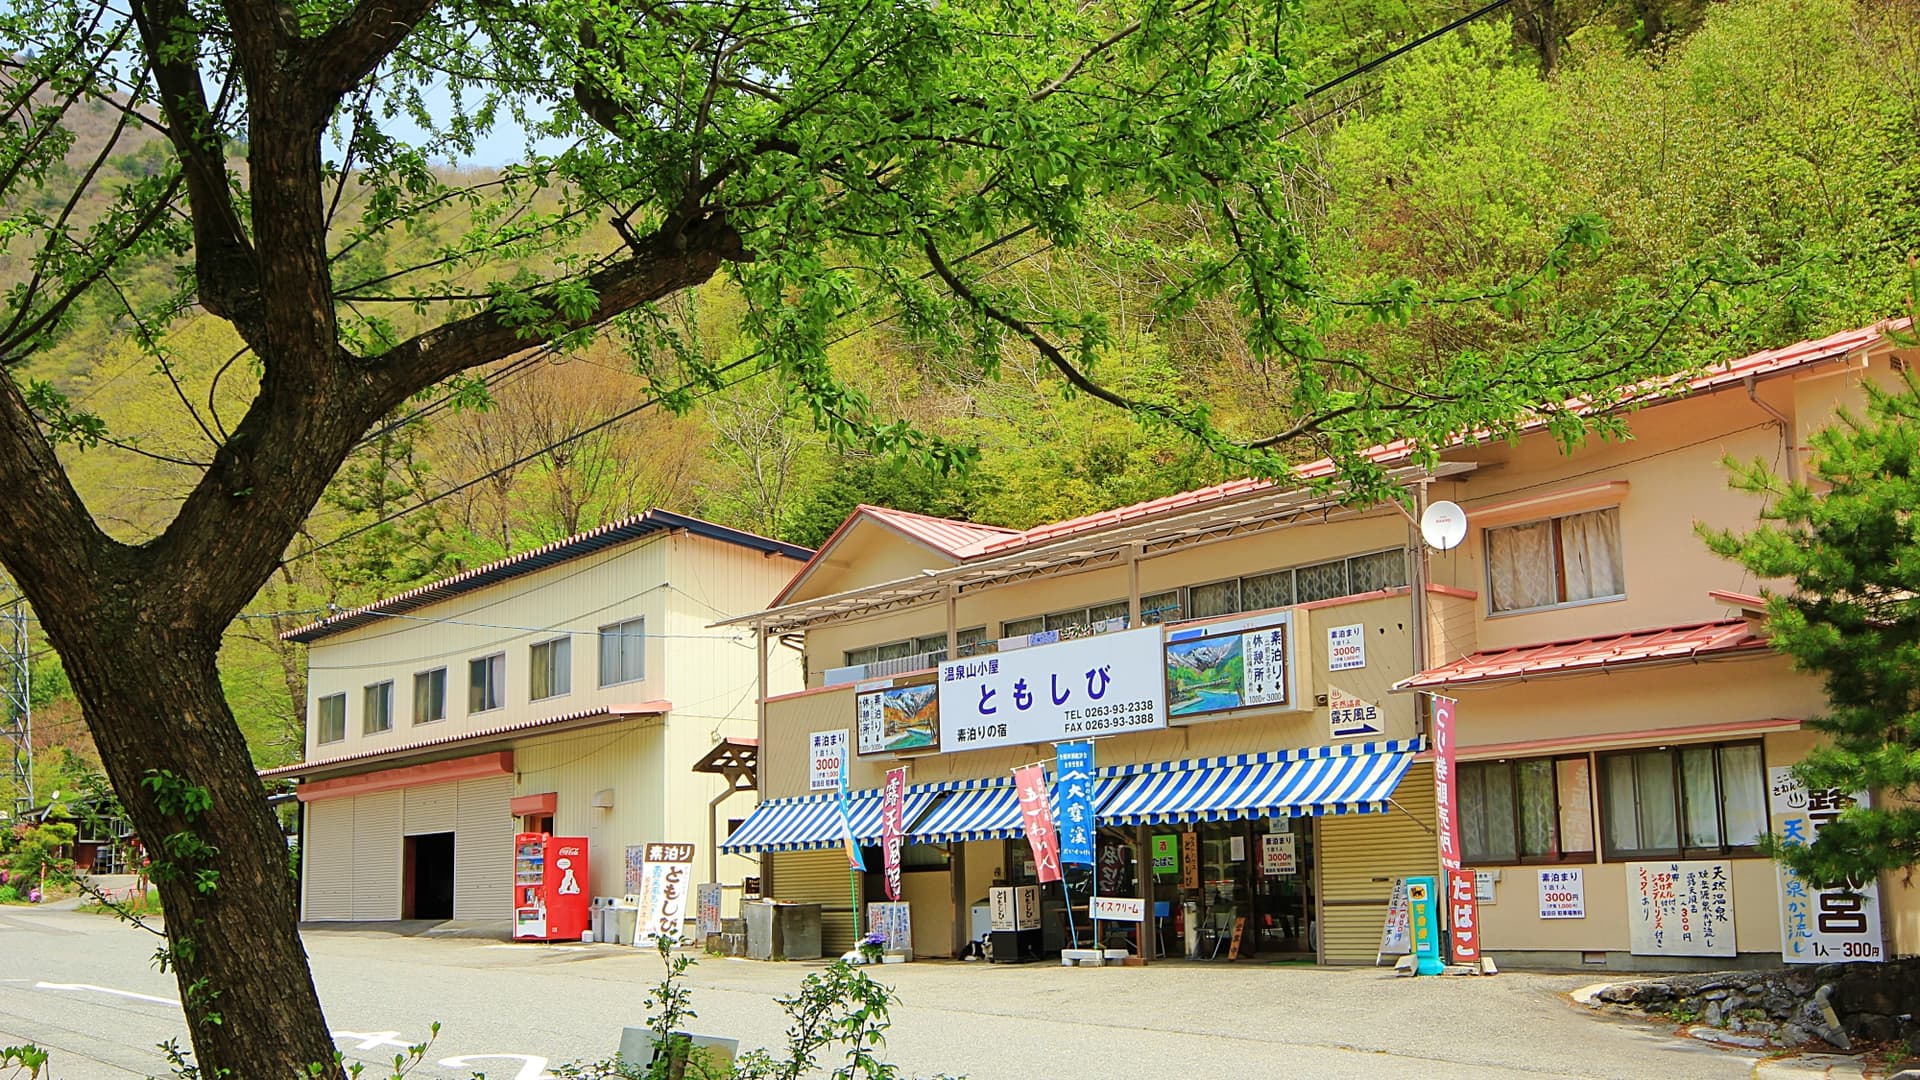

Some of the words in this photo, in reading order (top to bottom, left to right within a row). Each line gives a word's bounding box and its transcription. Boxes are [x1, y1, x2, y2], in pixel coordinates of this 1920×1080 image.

[1331, 627, 1360, 639] 素泊まり
[1252, 633, 1264, 682] 休憩所
[1271, 630, 1282, 680] 素泊り
[1333, 646, 1361, 656] 3000円
[944, 659, 1000, 682] 温泉山小屋
[978, 664, 1112, 715] ともしび
[1064, 710, 1083, 721] TEL
[1084, 700, 1154, 718] 0263-93-2338
[1331, 706, 1377, 725] 露天風呂
[956, 723, 1007, 743] 素泊りの宿
[1064, 723, 1083, 733] FAX
[1085, 713, 1154, 731] 0263-93-3388
[814, 733, 845, 747] 素泊まり
[1066, 783, 1087, 845] 大雪渓
[1265, 837, 1292, 846] 素泊まり
[649, 844, 692, 861] 素泊り
[1151, 857, 1175, 867] たばこ
[1267, 852, 1292, 862] 3000円
[1542, 871, 1578, 882] 素泊まり
[660, 866, 683, 932] ともしび
[1545, 892, 1579, 902] 3000円
[1712, 865, 1729, 923] 天然温泉
[1452, 875, 1475, 957] たばこ
